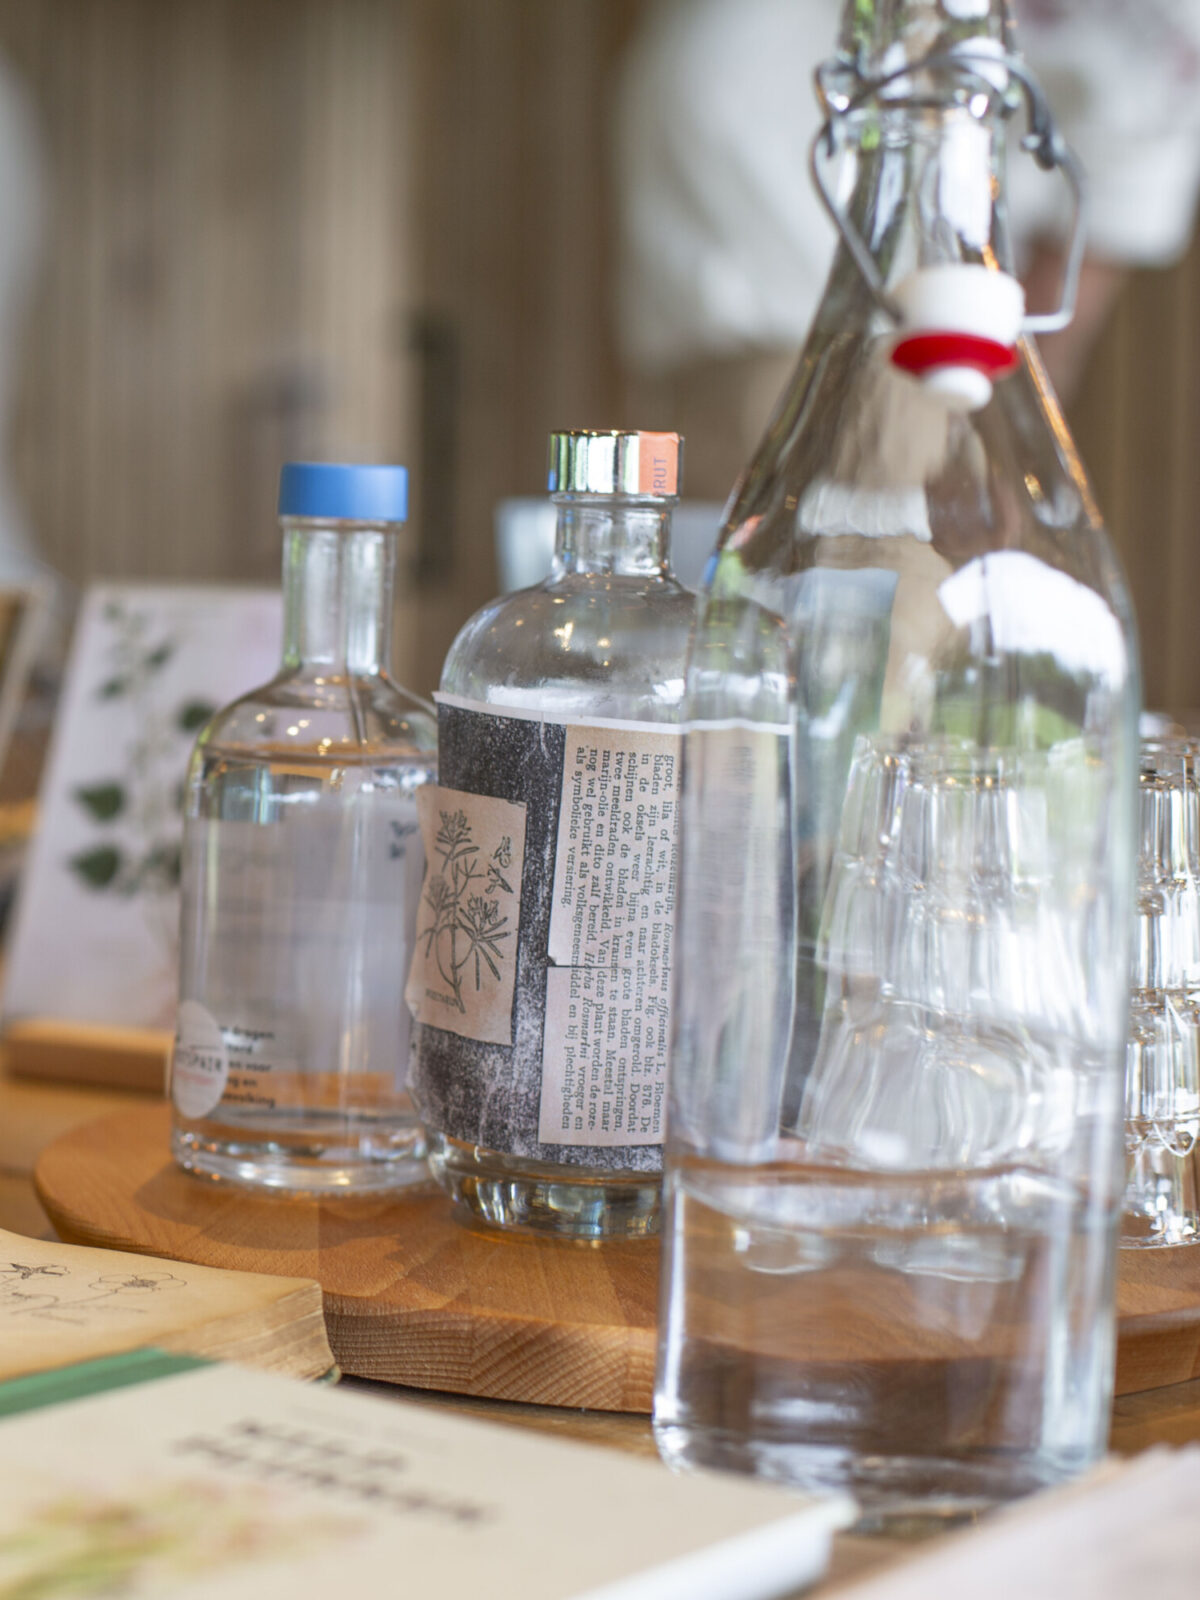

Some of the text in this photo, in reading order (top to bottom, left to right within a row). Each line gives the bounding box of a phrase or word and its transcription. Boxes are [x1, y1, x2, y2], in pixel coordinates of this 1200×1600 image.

[577, 747, 585, 764] als
[587, 749, 597, 771] nog
[598, 750, 612, 817] marijn-olie
[663, 755, 674, 791] groot,
[586, 778, 597, 798] wel
[662, 801, 672, 820] lila
[581, 804, 593, 856] gebruikt
[596, 824, 605, 837] en
[661, 829, 669, 842] of
[593, 844, 605, 869] dito
[656, 851, 667, 873] wit,
[562, 846, 576, 908] versiering.
[579, 862, 589, 879] als
[590, 875, 601, 898] zalf
[656, 882, 665, 894] in
[654, 901, 664, 915] de
[585, 905, 599, 944] bereid.
[588, 751, 625, 1130] twee meeldraden ontwikkeld. Van deze plant worden de roze-
[601, 752, 638, 1132] schijnen ook de bladen in kransen te staan. Meestal maar
[613, 754, 651, 1132] in de oksels weer bijna even grote bladen ontspringen.
[628, 754, 663, 1133] bladen zijn leerachtig en naar achteren omgerold. Doordat
[661, 923, 673, 991] Rosmarinus
[569, 1004, 578, 1018] en
[646, 996, 657, 1019] Fig.
[565, 1025, 578, 1039] bij
[580, 997, 593, 1060] Rosmarini
[646, 1027, 655, 1048] ook
[658, 998, 668, 1057] officinalis
[561, 1046, 575, 1130] plechtigheden
[575, 1066, 586, 1111] vroeger
[653, 1082, 664, 1134] Bloemen
[575, 1116, 583, 1130] en
[640, 1116, 650, 1133] De
